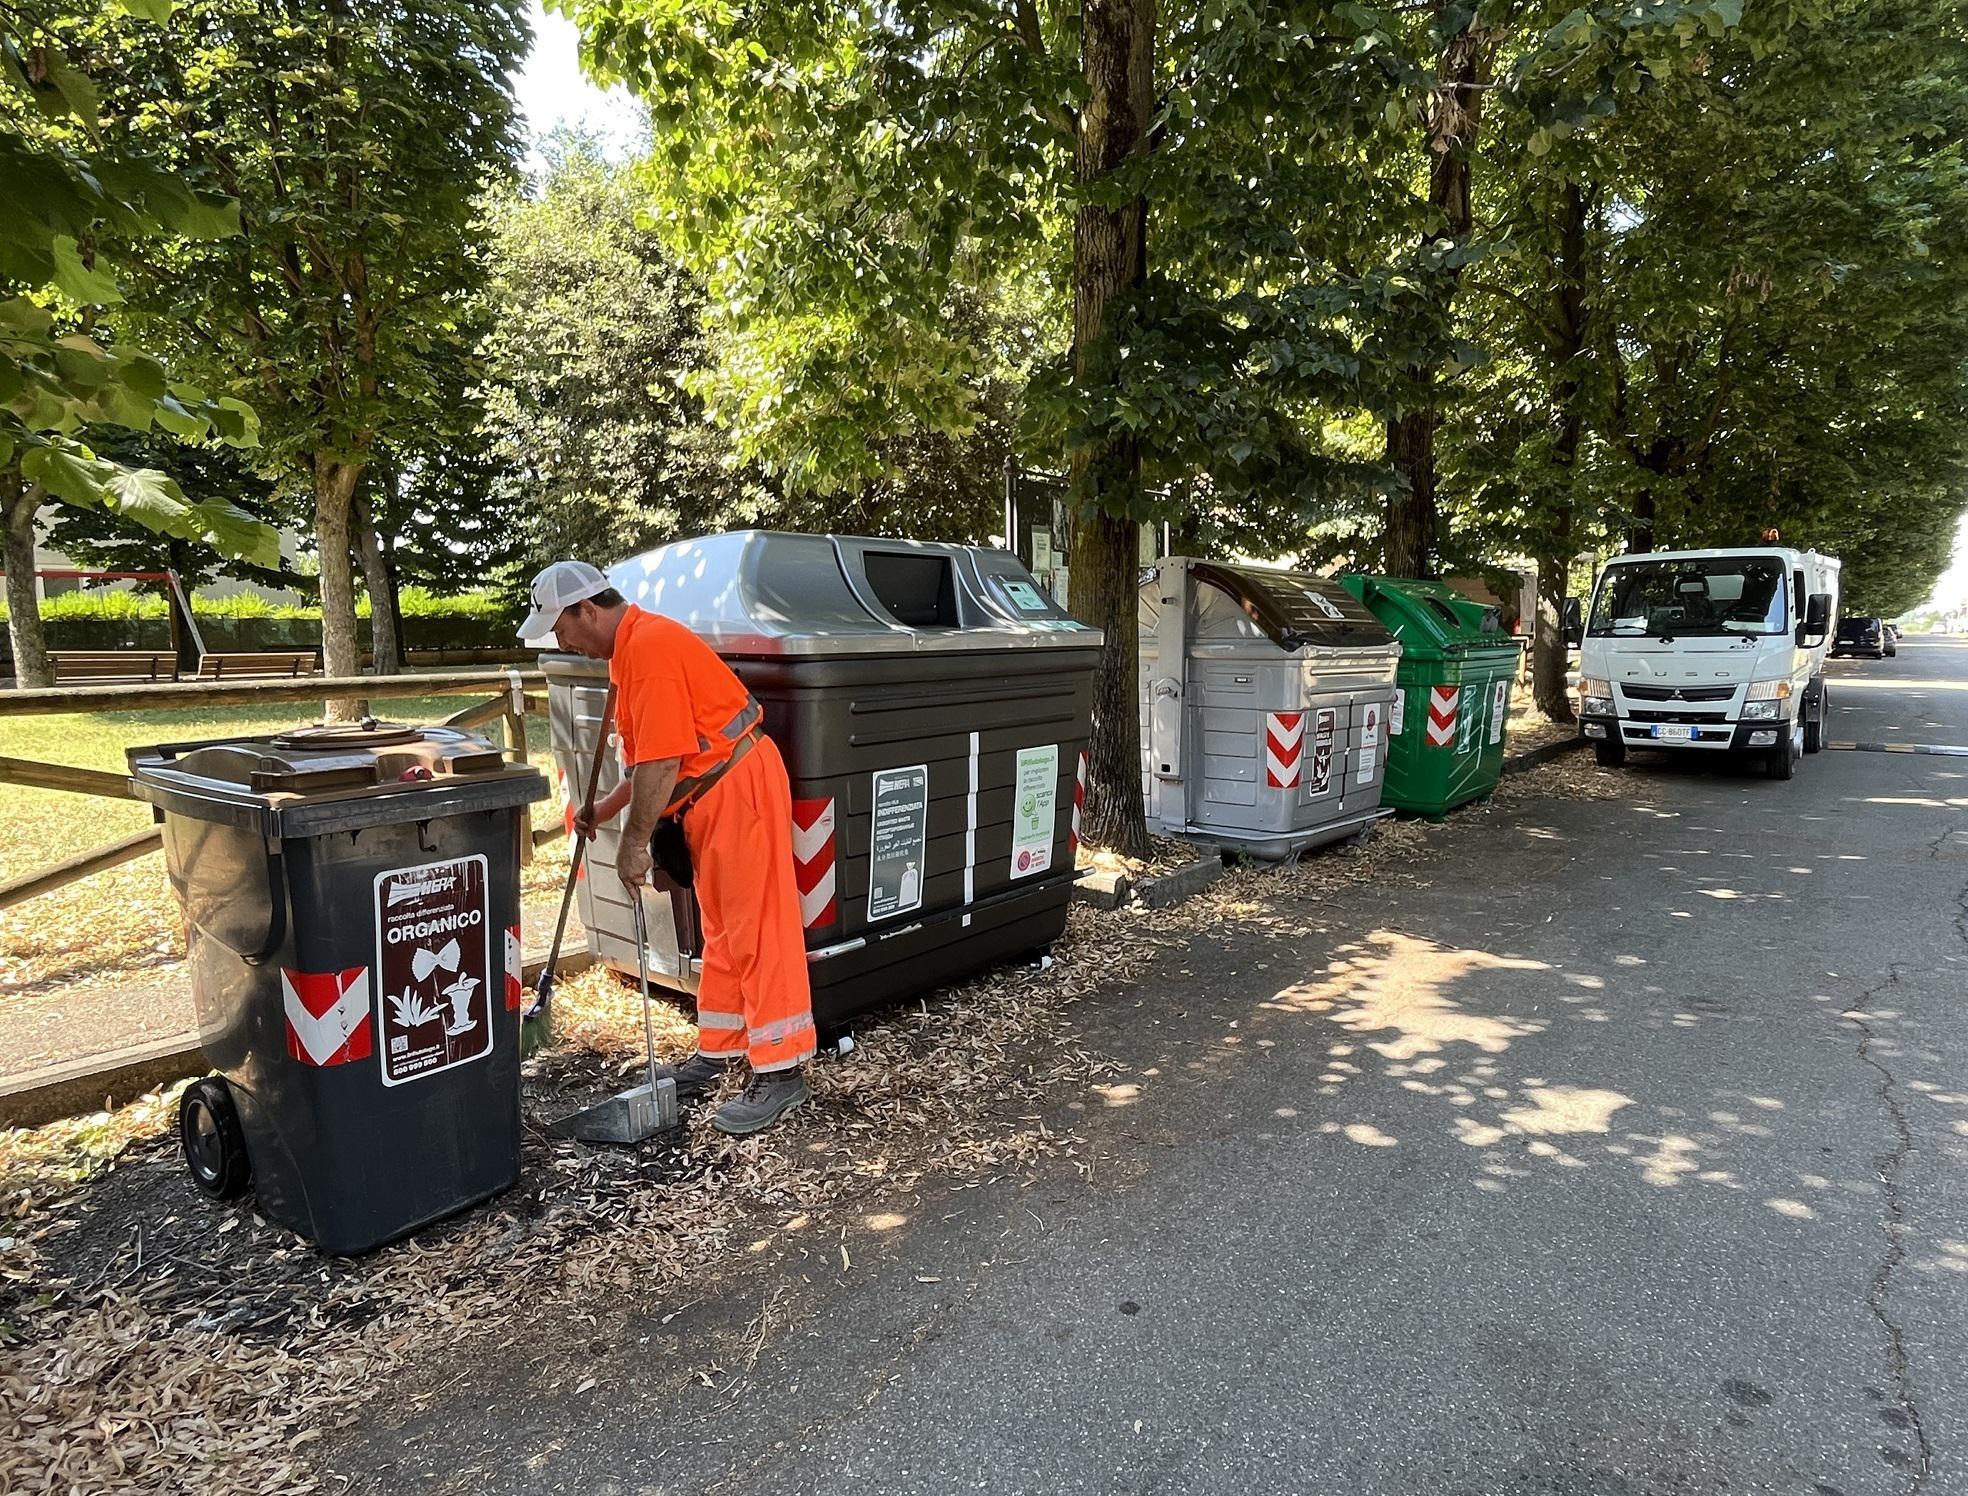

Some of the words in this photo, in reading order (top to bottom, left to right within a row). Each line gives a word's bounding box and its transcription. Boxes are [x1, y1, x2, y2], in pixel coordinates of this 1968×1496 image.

[387, 912, 416, 923] raccolta
[416, 903, 455, 918] differenziata
[387, 909, 482, 944] ORGANICO
